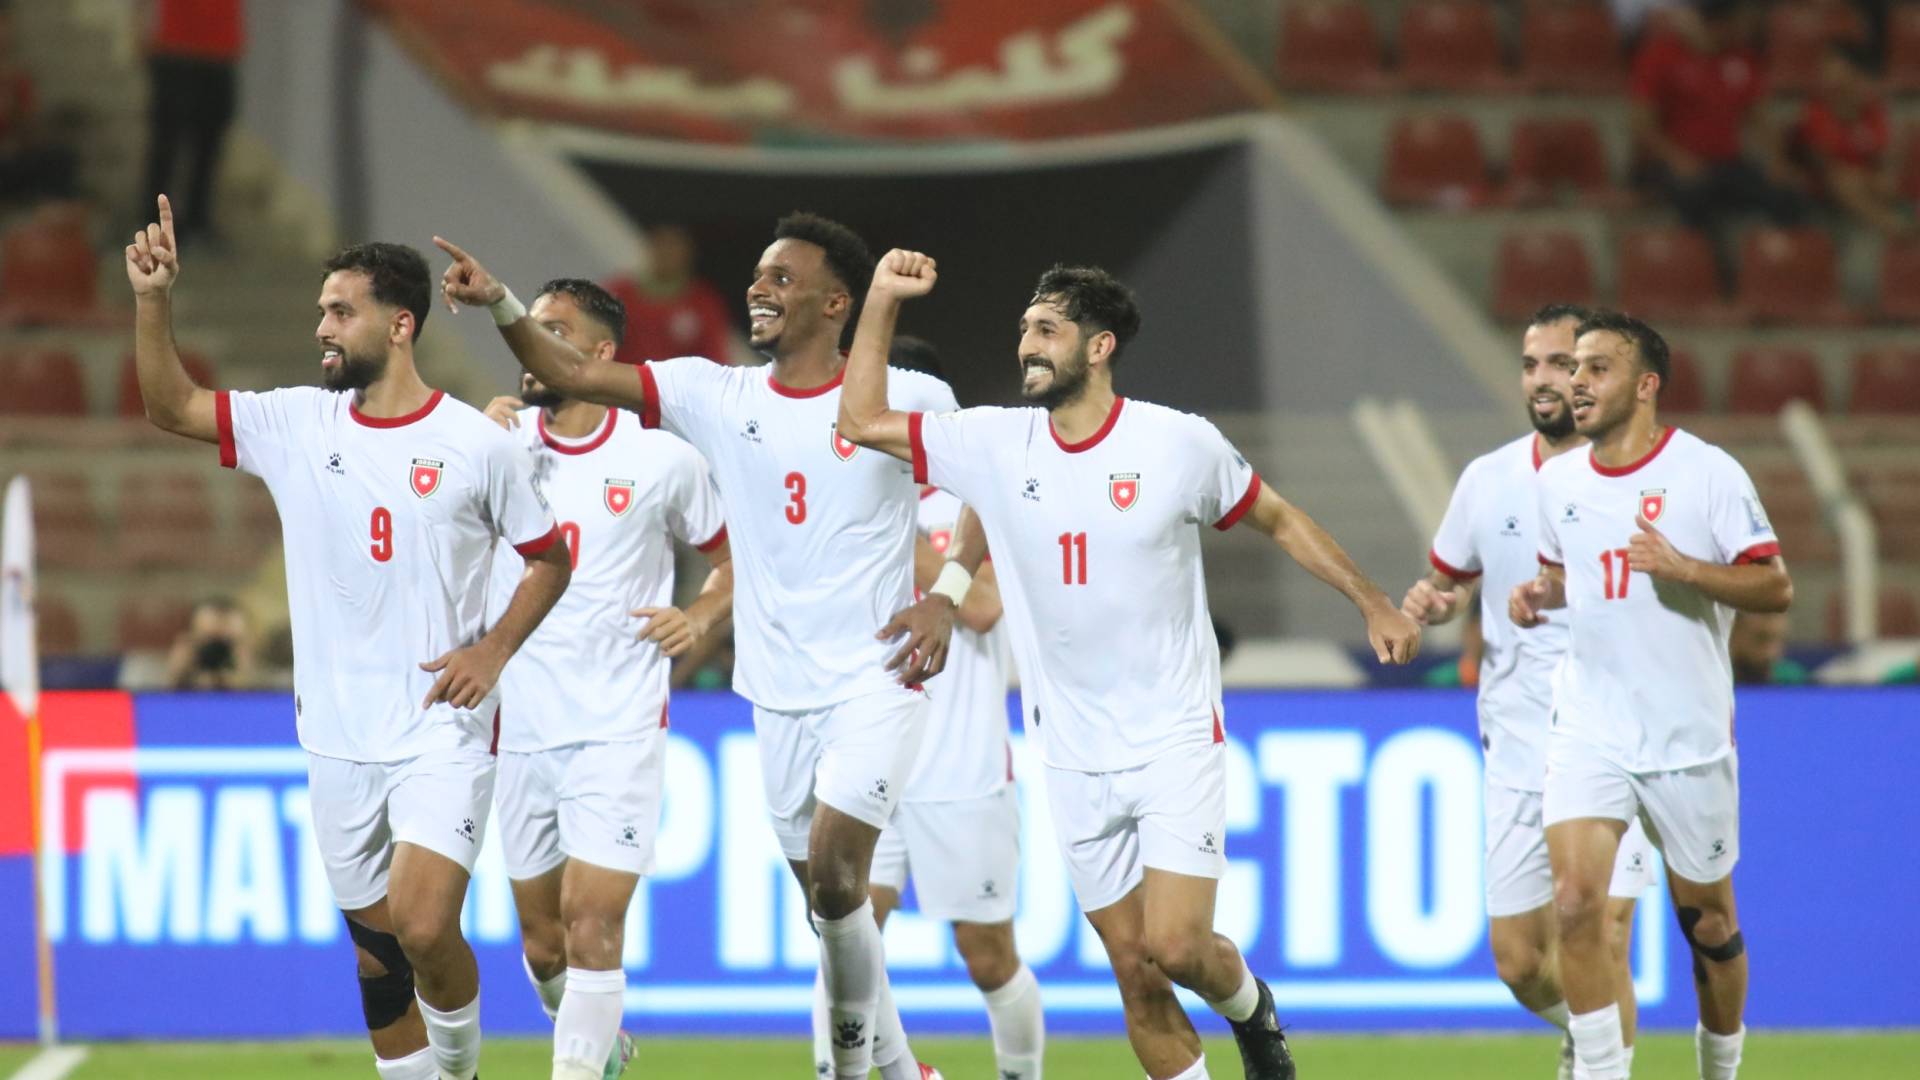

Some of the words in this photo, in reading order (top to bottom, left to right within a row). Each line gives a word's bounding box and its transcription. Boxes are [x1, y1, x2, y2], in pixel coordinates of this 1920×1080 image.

[784, 471, 807, 525] 3
[370, 506, 393, 562] 9
[1058, 532, 1087, 585] 11
[1600, 549, 1631, 600] 17
